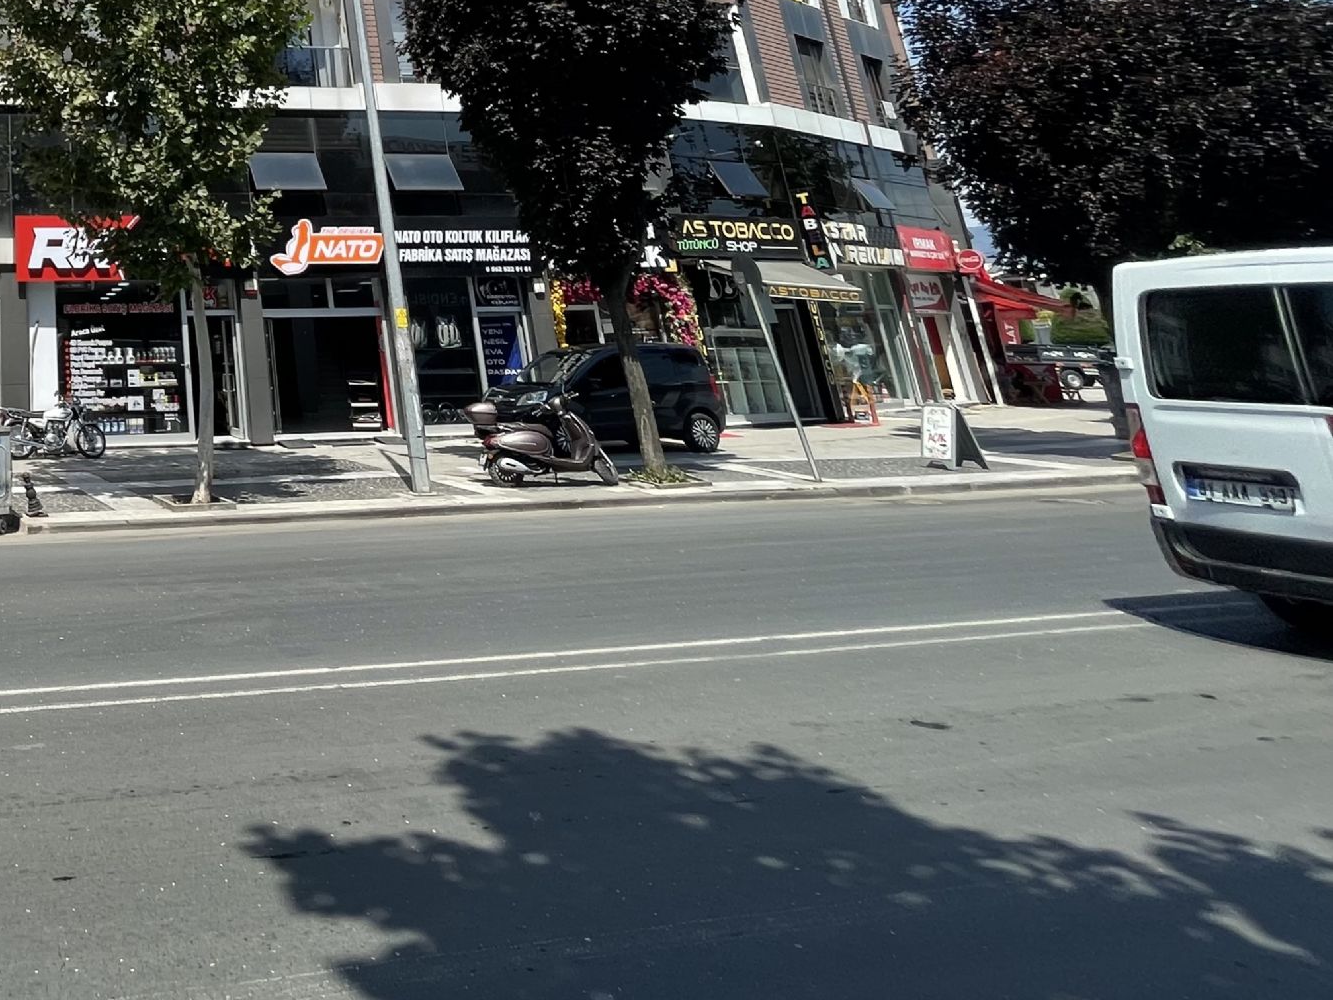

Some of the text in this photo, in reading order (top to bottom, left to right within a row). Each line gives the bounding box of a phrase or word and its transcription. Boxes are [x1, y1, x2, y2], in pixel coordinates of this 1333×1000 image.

[394, 230, 421, 243] NATO
[423, 230, 442, 243] OTO
[445, 230, 483, 243] KOLTUK
[682, 220, 795, 241] AS TOBACCO
[314, 240, 377, 258] NATO
[399, 245, 443, 262] FABRİKA
[444, 248, 473, 263] SATIŞ
[726, 241, 758, 252] SHOP
[769, 286, 860, 300] ASTOBACCO
